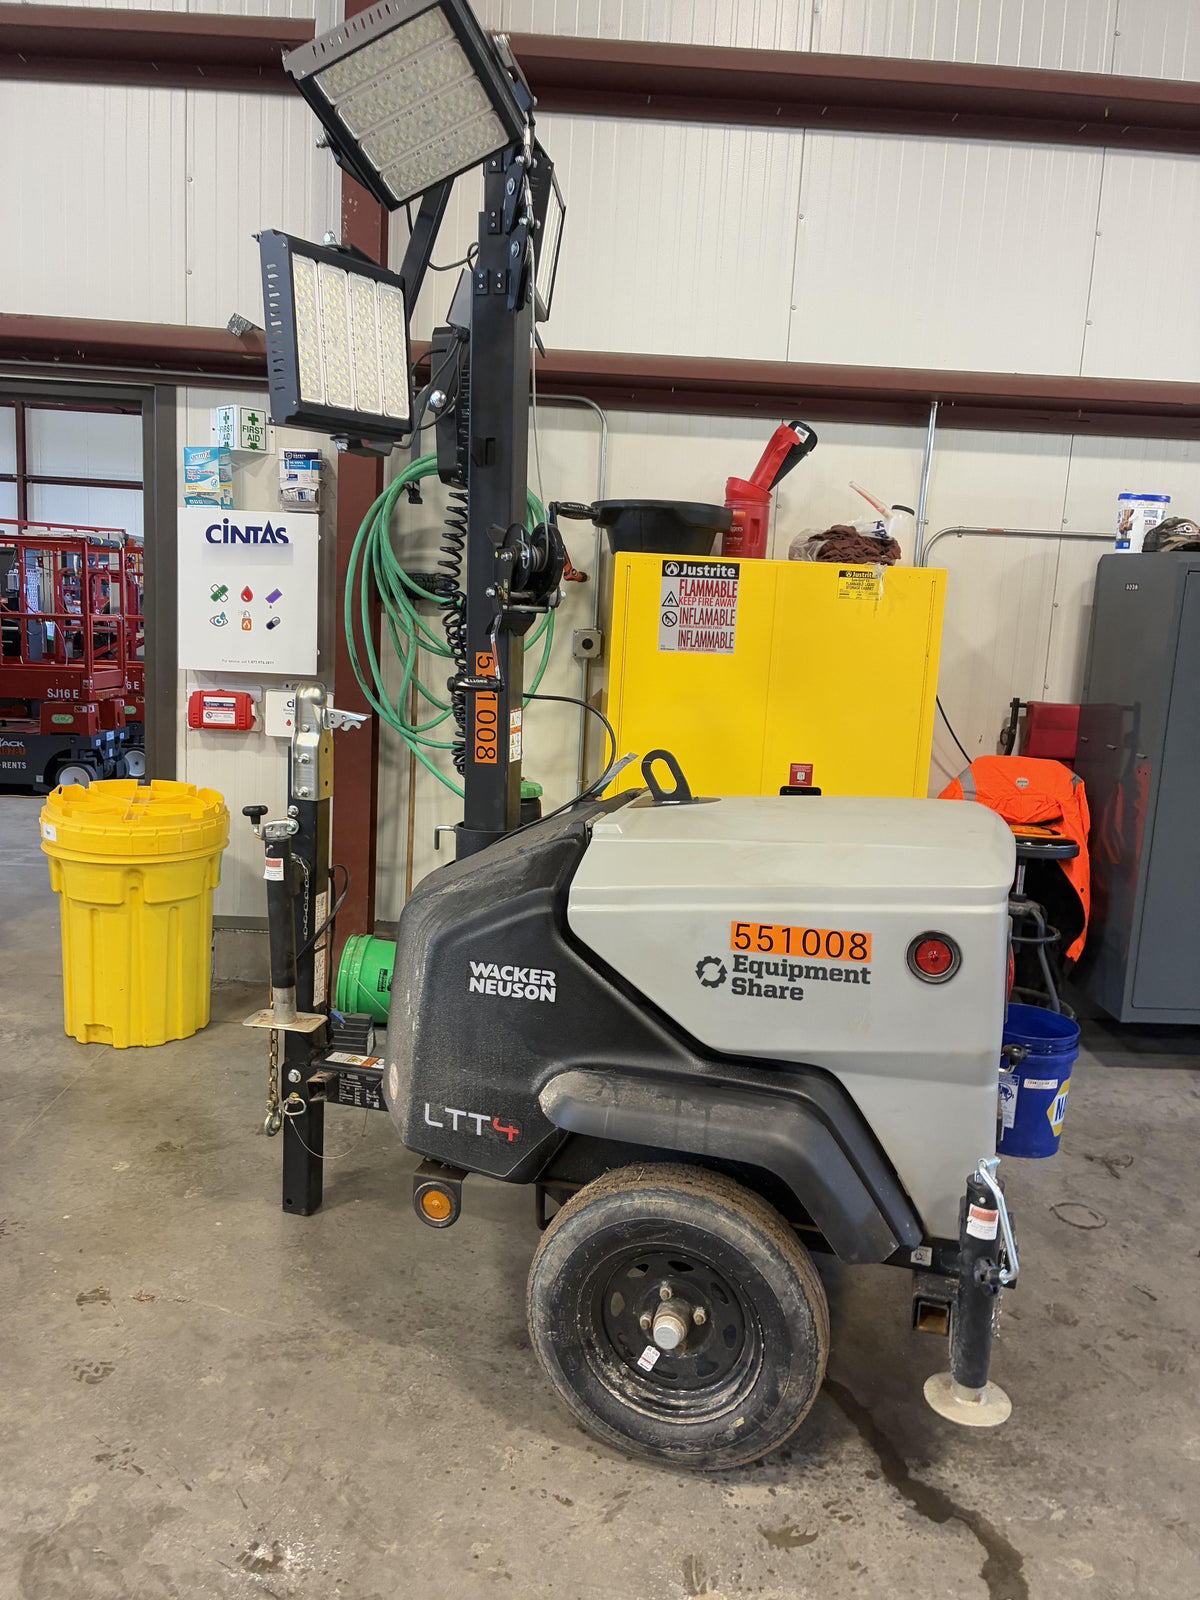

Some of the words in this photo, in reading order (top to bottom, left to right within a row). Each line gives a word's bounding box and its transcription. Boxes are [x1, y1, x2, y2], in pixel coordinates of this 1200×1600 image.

[242, 425, 264, 435] FIRST
[247, 434, 260, 442] AID
[680, 563, 736, 577] Justrite
[679, 578, 738, 598] FLAMMABLE
[678, 597, 697, 606] KEEP
[697, 597, 714, 607] FIRE
[714, 598, 737, 608] AWAY
[679, 607, 736, 627] INFLAMABLE
[677, 630, 735, 649] INFLAMMABLE
[47, 688, 71, 698] SJ16
[72, 689, 79, 699] E
[133, 681, 140, 690] E
[733, 922, 868, 961] 551008
[469, 960, 557, 987] WACKER
[732, 954, 872, 985] Equipment
[469, 976, 557, 1003] NEUSON
[731, 976, 804, 1001] Share
[424, 1102, 519, 1142] LTT4
